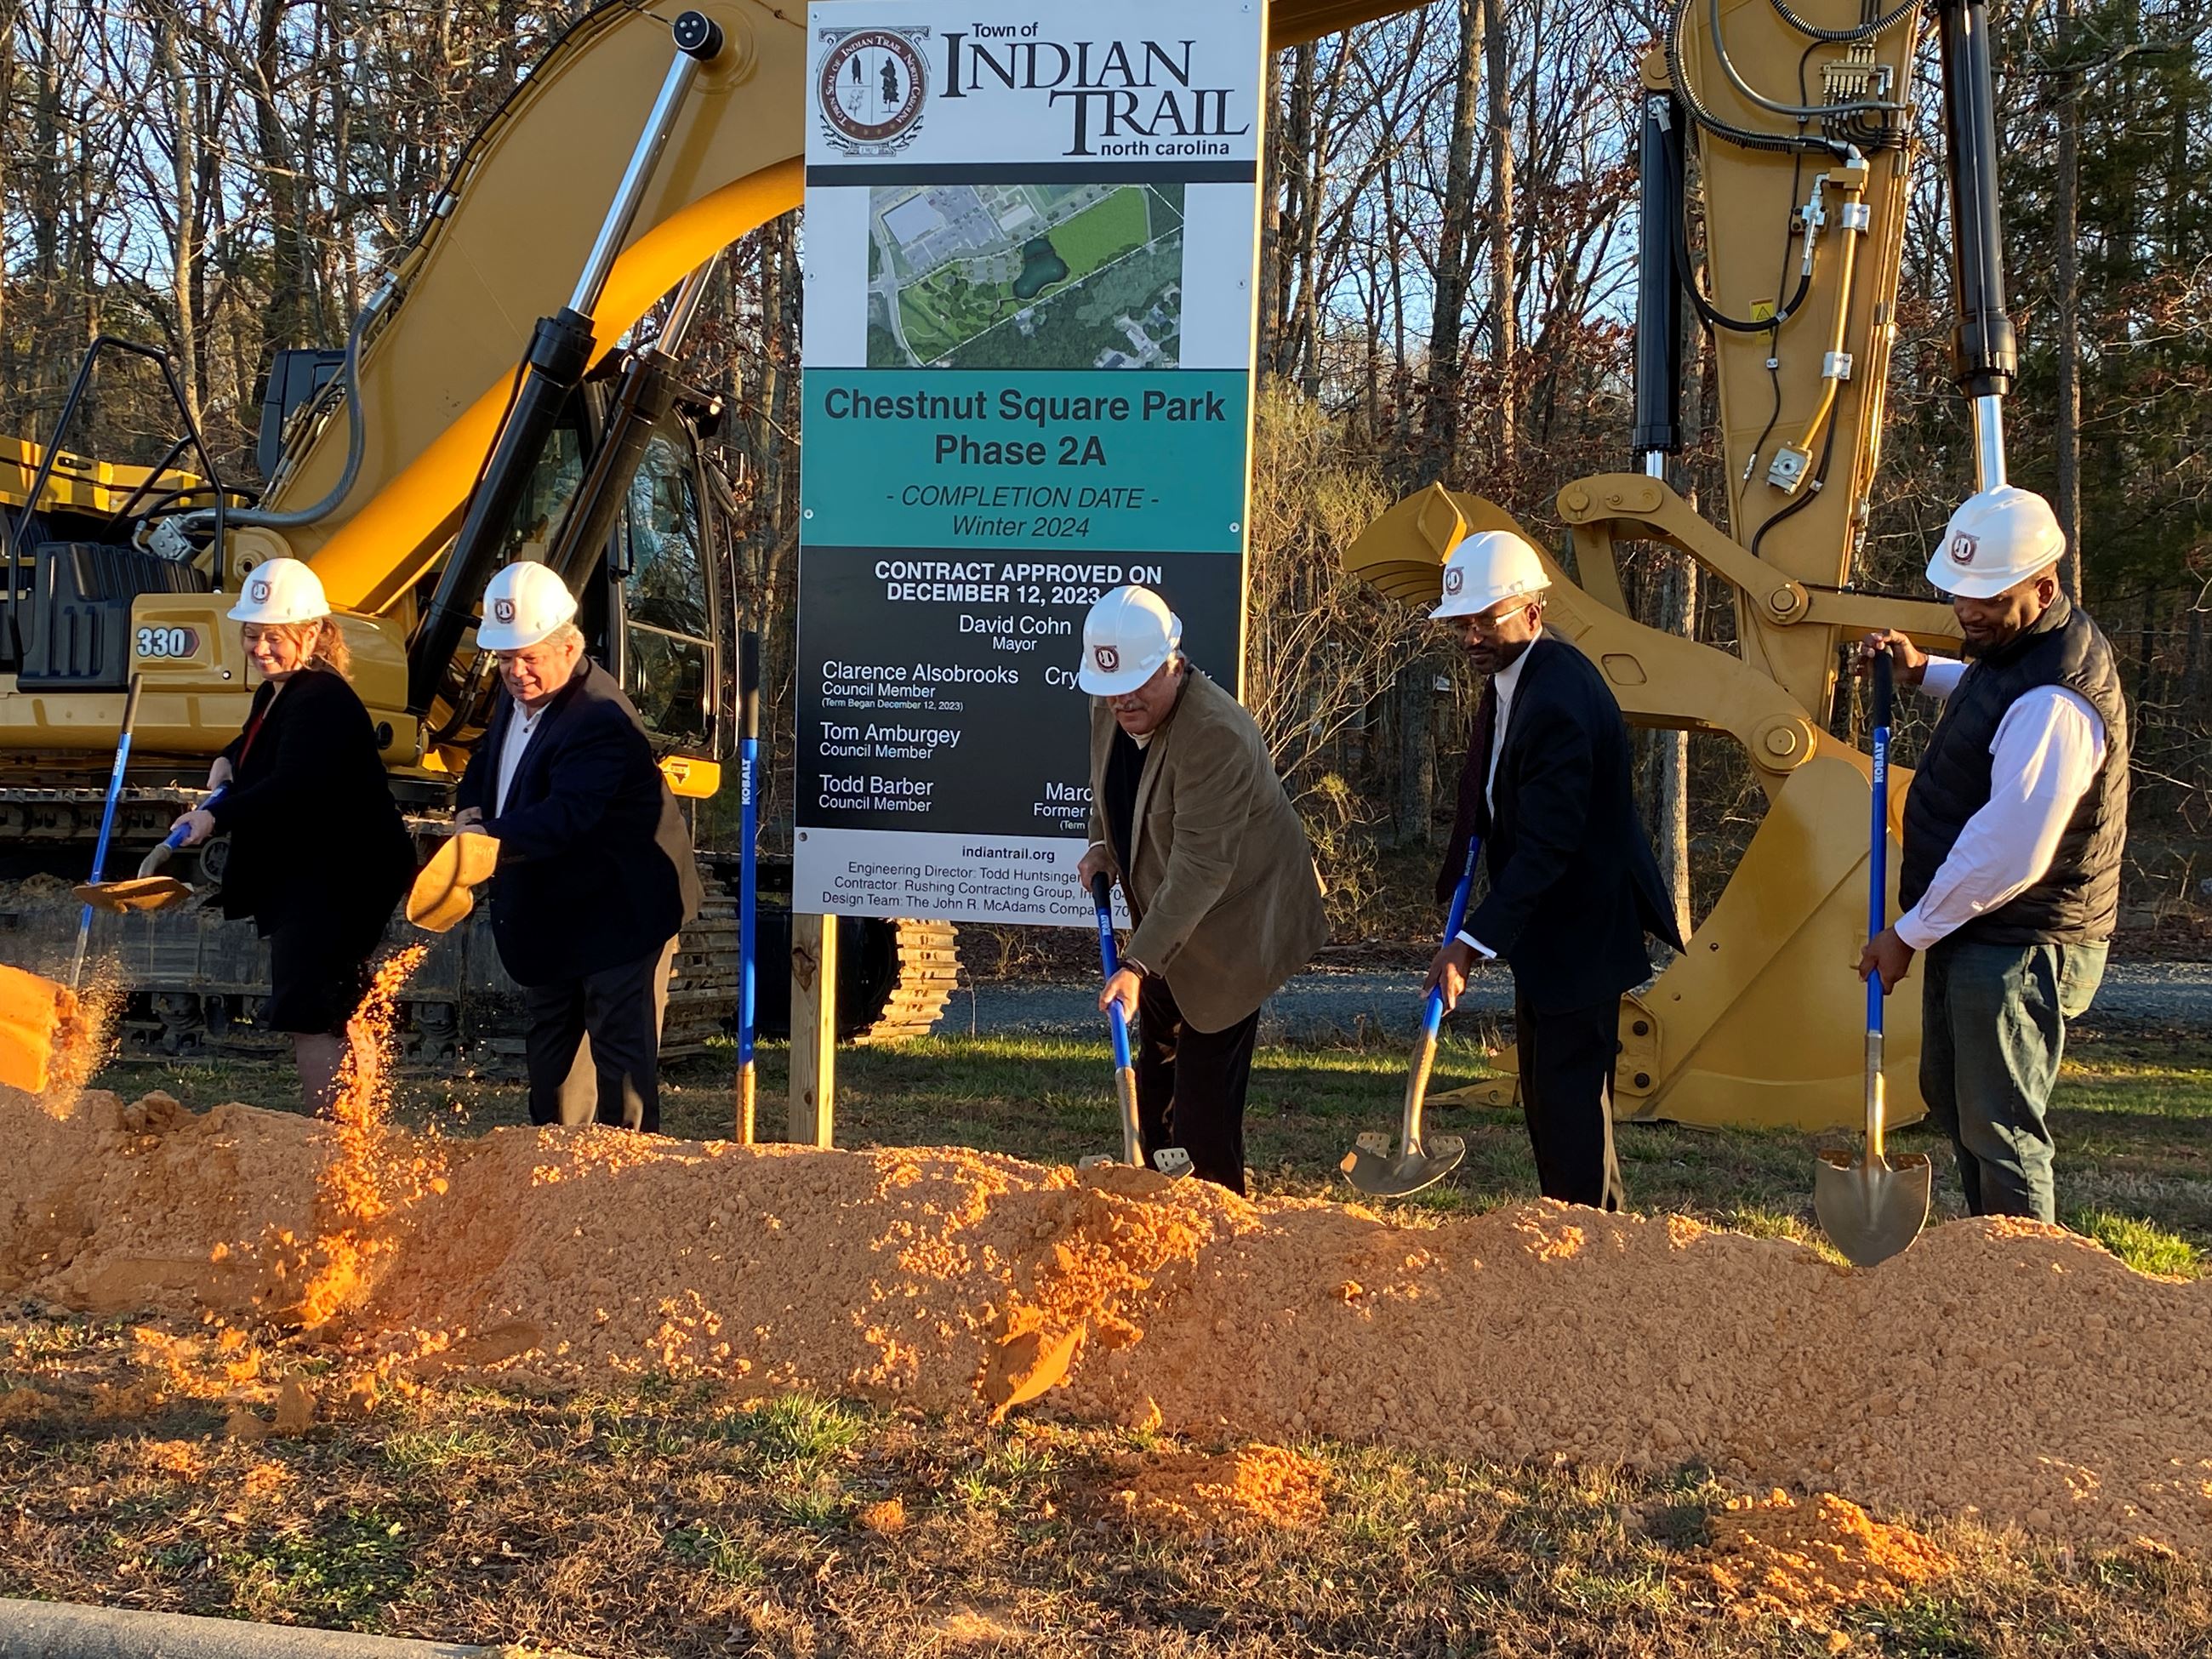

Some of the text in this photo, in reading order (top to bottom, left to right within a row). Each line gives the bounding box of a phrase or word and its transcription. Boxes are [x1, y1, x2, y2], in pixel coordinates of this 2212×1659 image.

[972, 22, 1038, 37] Town of
[939, 32, 1196, 97] INDIAN
[1049, 89, 1250, 156] TRAIL
[1102, 140, 1229, 156] north carolina
[825, 389, 1225, 428] Chestnut Square Park
[936, 435, 1106, 465] Phase 2A
[903, 485, 1072, 507] COMPLETION
[1078, 488, 1145, 508] DATE
[955, 516, 1089, 537] Winter 2024
[875, 562, 1161, 584] CONTRACT APPROVED ON
[888, 583, 1100, 607] DECEMBER 12, 2023
[960, 615, 1070, 635] David Cohn
[137, 628, 185, 657] 330
[994, 636, 1037, 653] Mayor
[824, 661, 1018, 683] Clarence Alsobrooks
[823, 681, 936, 698] Council Member
[822, 698, 963, 712] (Term Began December 12, 2023)
[820, 721, 961, 748] Tom Amburgey
[820, 742, 932, 759] Council Member
[1874, 742, 1884, 783] KOBALT
[742, 758, 751, 806] KOBALT
[819, 774, 933, 795] Todd Barber
[819, 795, 932, 812] Council Member
[1035, 803, 1086, 817] Former
[1060, 820, 1085, 830] (Term
[963, 846, 1054, 863] indiantrail.org
[849, 861, 921, 879] Engineering
[926, 865, 976, 878] Director:
[980, 868, 1009, 880] Todd
[835, 876, 901, 890] Contractor:
[905, 880, 955, 896] Rushing
[959, 882, 1029, 899] Contracting
[1034, 885, 1075, 900] Group,
[823, 892, 863, 907] Design
[867, 893, 902, 906] Team:
[906, 895, 929, 908] The
[932, 898, 962, 909] John
[967, 898, 979, 910] R.
[984, 899, 1046, 913] McAdams
